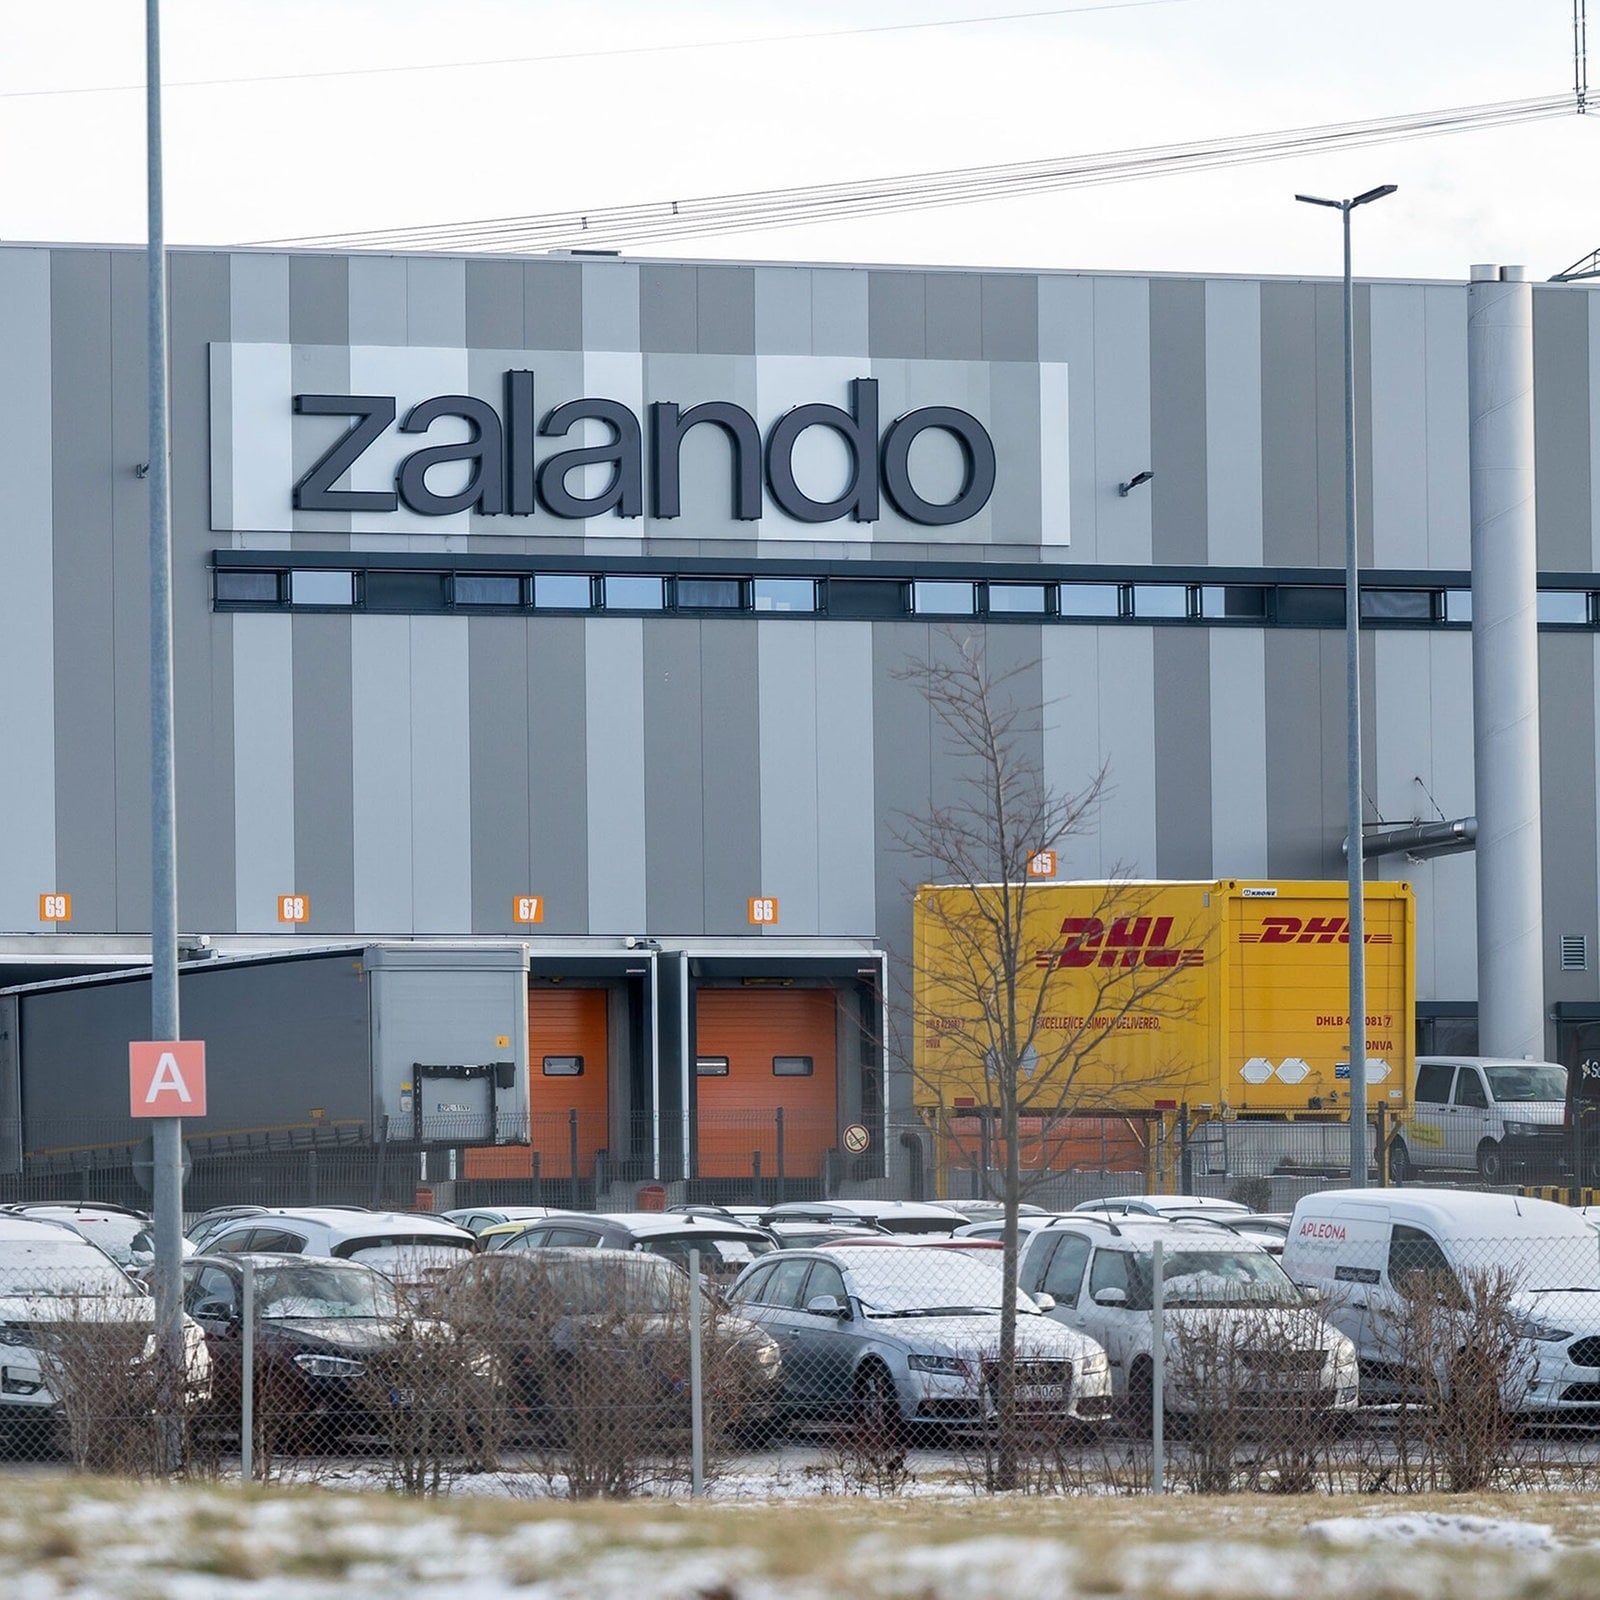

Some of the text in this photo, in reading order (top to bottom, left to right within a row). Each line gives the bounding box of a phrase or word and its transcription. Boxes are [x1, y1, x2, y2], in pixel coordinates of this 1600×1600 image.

[292, 368, 996, 526] zalando
[1032, 853, 1051, 873] 65
[45, 896, 65, 917] 69
[284, 898, 304, 919] 68
[519, 898, 538, 920] 67
[753, 900, 773, 920] 66
[1058, 917, 1182, 967] DHL
[1087, 1016, 1116, 1029] SIMPLY
[1316, 1016, 1343, 1026] DHLB
[1365, 1040, 1393, 1050] DNVA
[145, 1052, 192, 1103] A
[1300, 1223, 1346, 1240] APLEONA
